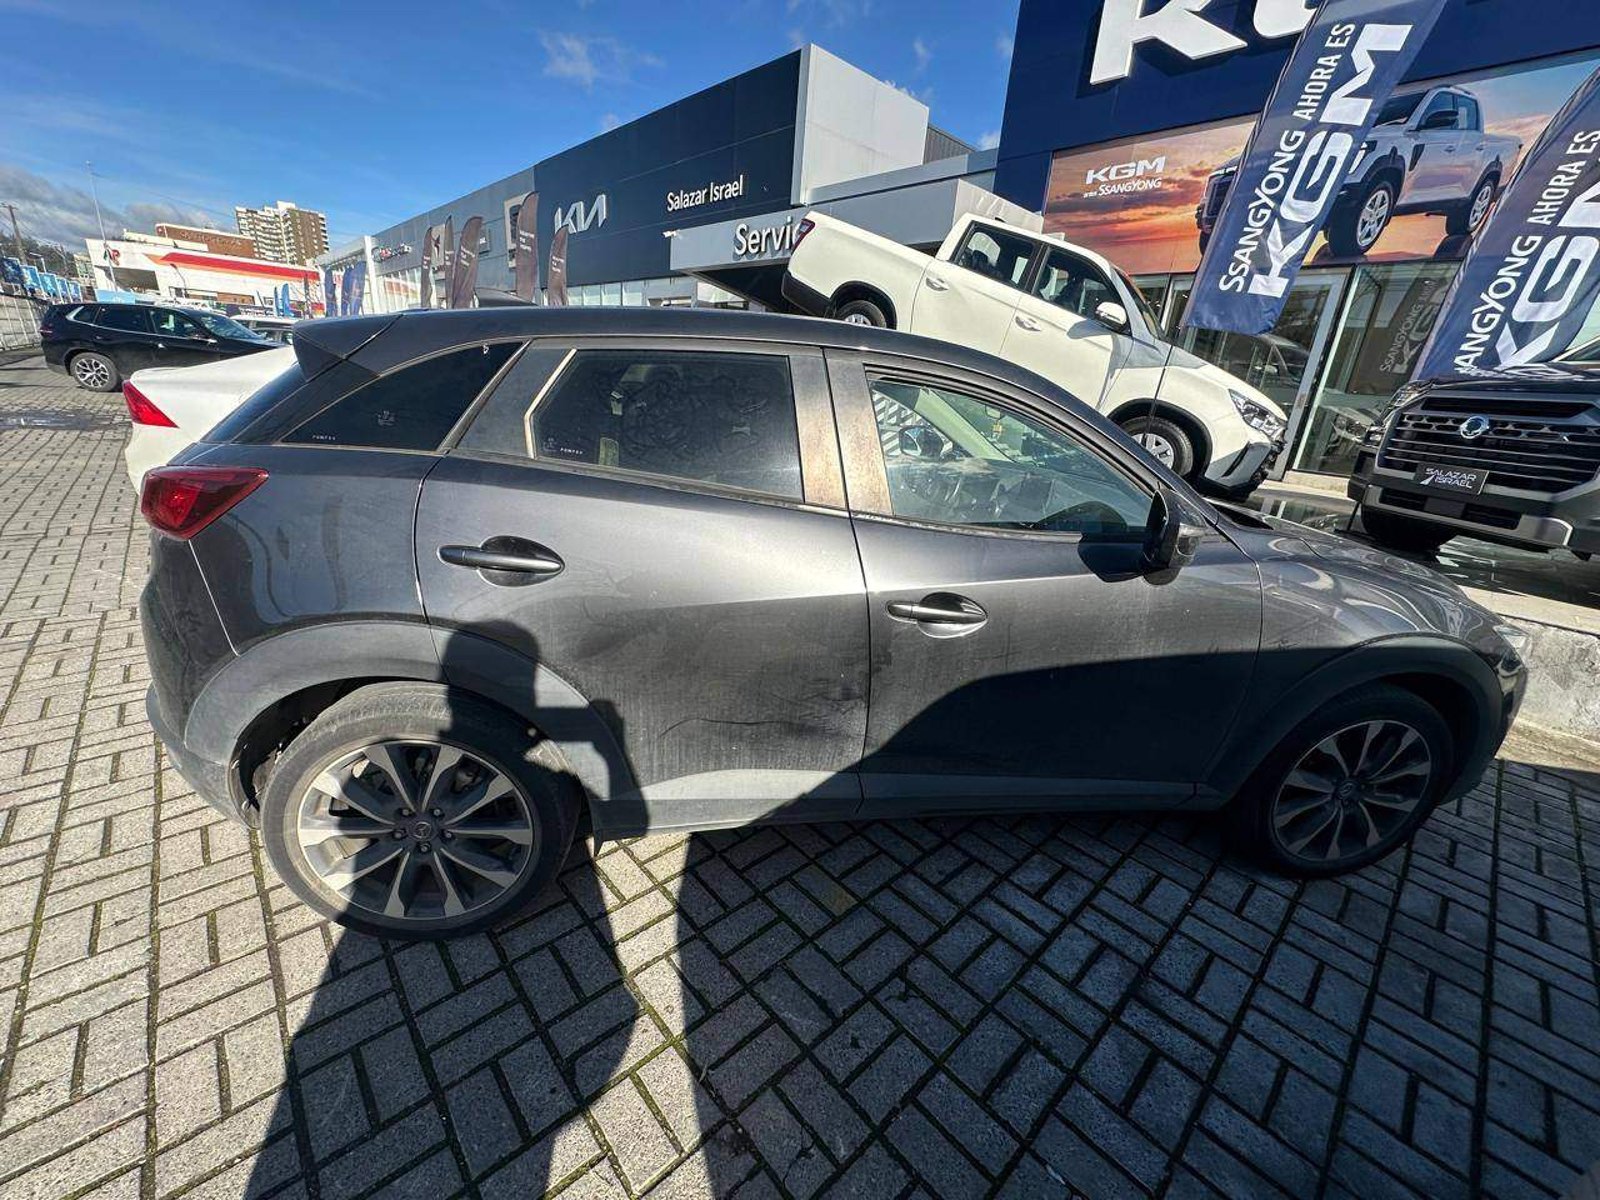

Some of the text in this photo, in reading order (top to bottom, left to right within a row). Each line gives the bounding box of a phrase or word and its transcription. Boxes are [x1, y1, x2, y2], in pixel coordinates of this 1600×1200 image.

[1085, 156, 1166, 185] KGM
[1218, 23, 1356, 293] SSANGYONG AHORA ES
[1247, 23, 1413, 299] KGM
[666, 174, 744, 212] Salazar Israel
[1098, 177, 1162, 196] SSANGYONG
[1453, 129, 1600, 369] ANGYONG AHORA ES
[1425, 467, 1477, 481] SALAZAR
[1434, 475, 1473, 489] ISRAEL
